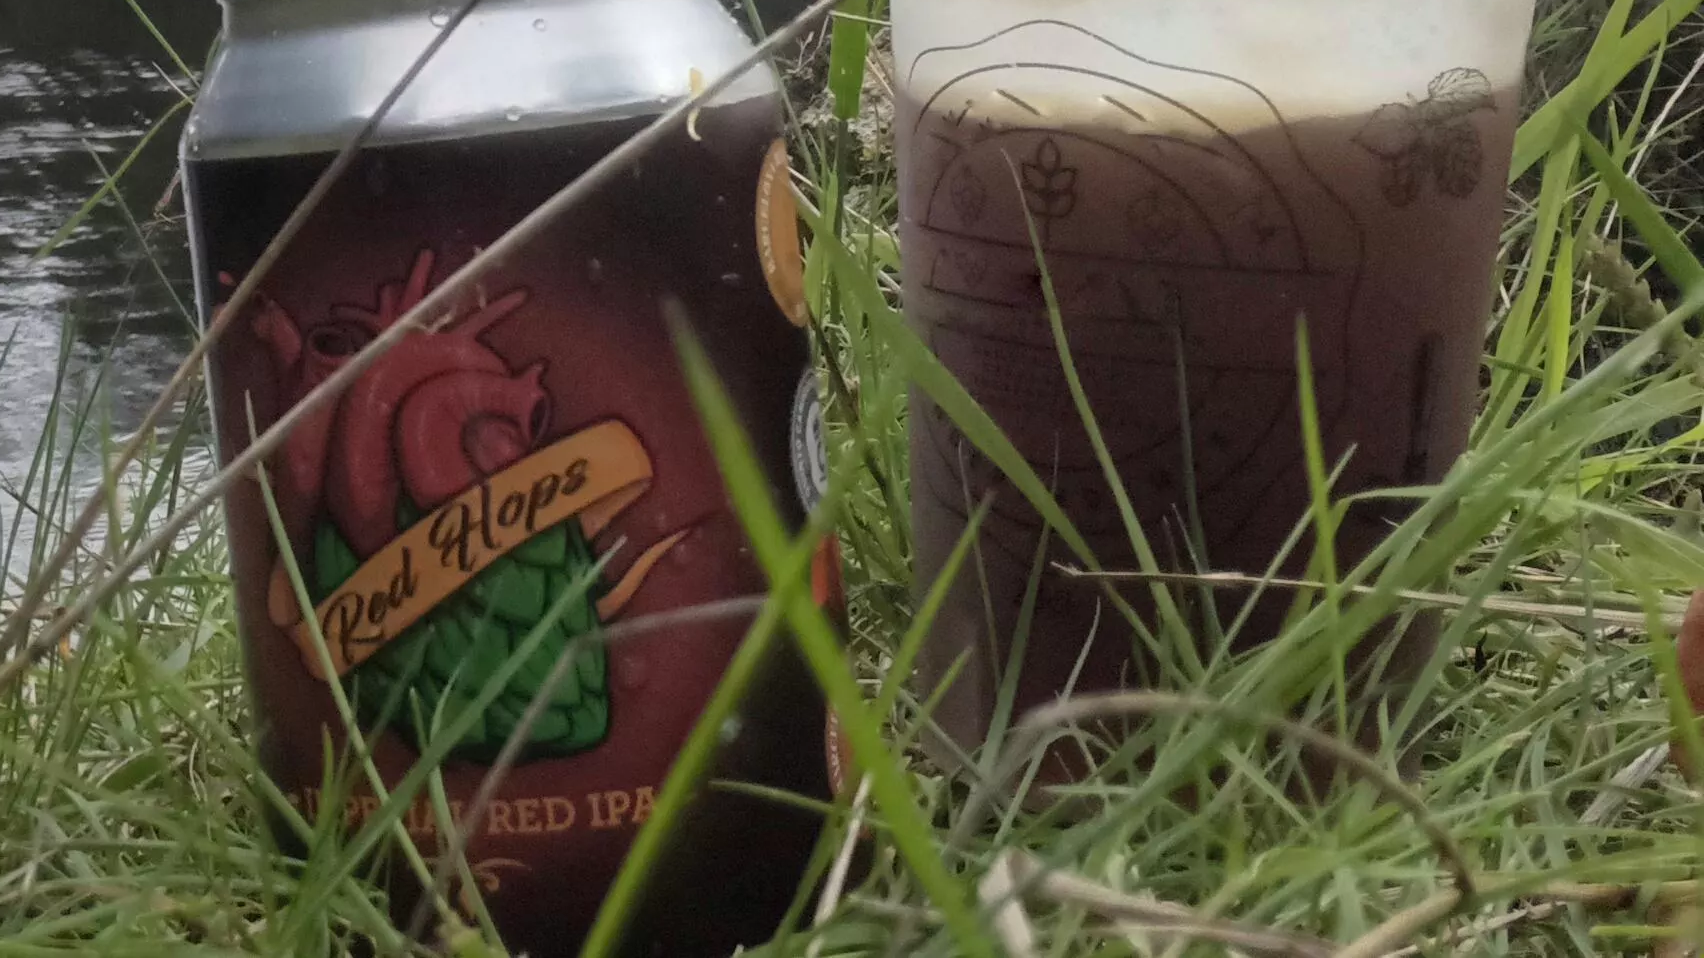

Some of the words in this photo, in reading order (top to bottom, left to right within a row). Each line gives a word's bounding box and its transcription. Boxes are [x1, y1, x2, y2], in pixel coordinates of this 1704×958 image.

[322, 545, 418, 666] Red
[428, 457, 590, 572] Hops
[487, 796, 577, 835] RED
[587, 786, 659, 828] IPA
